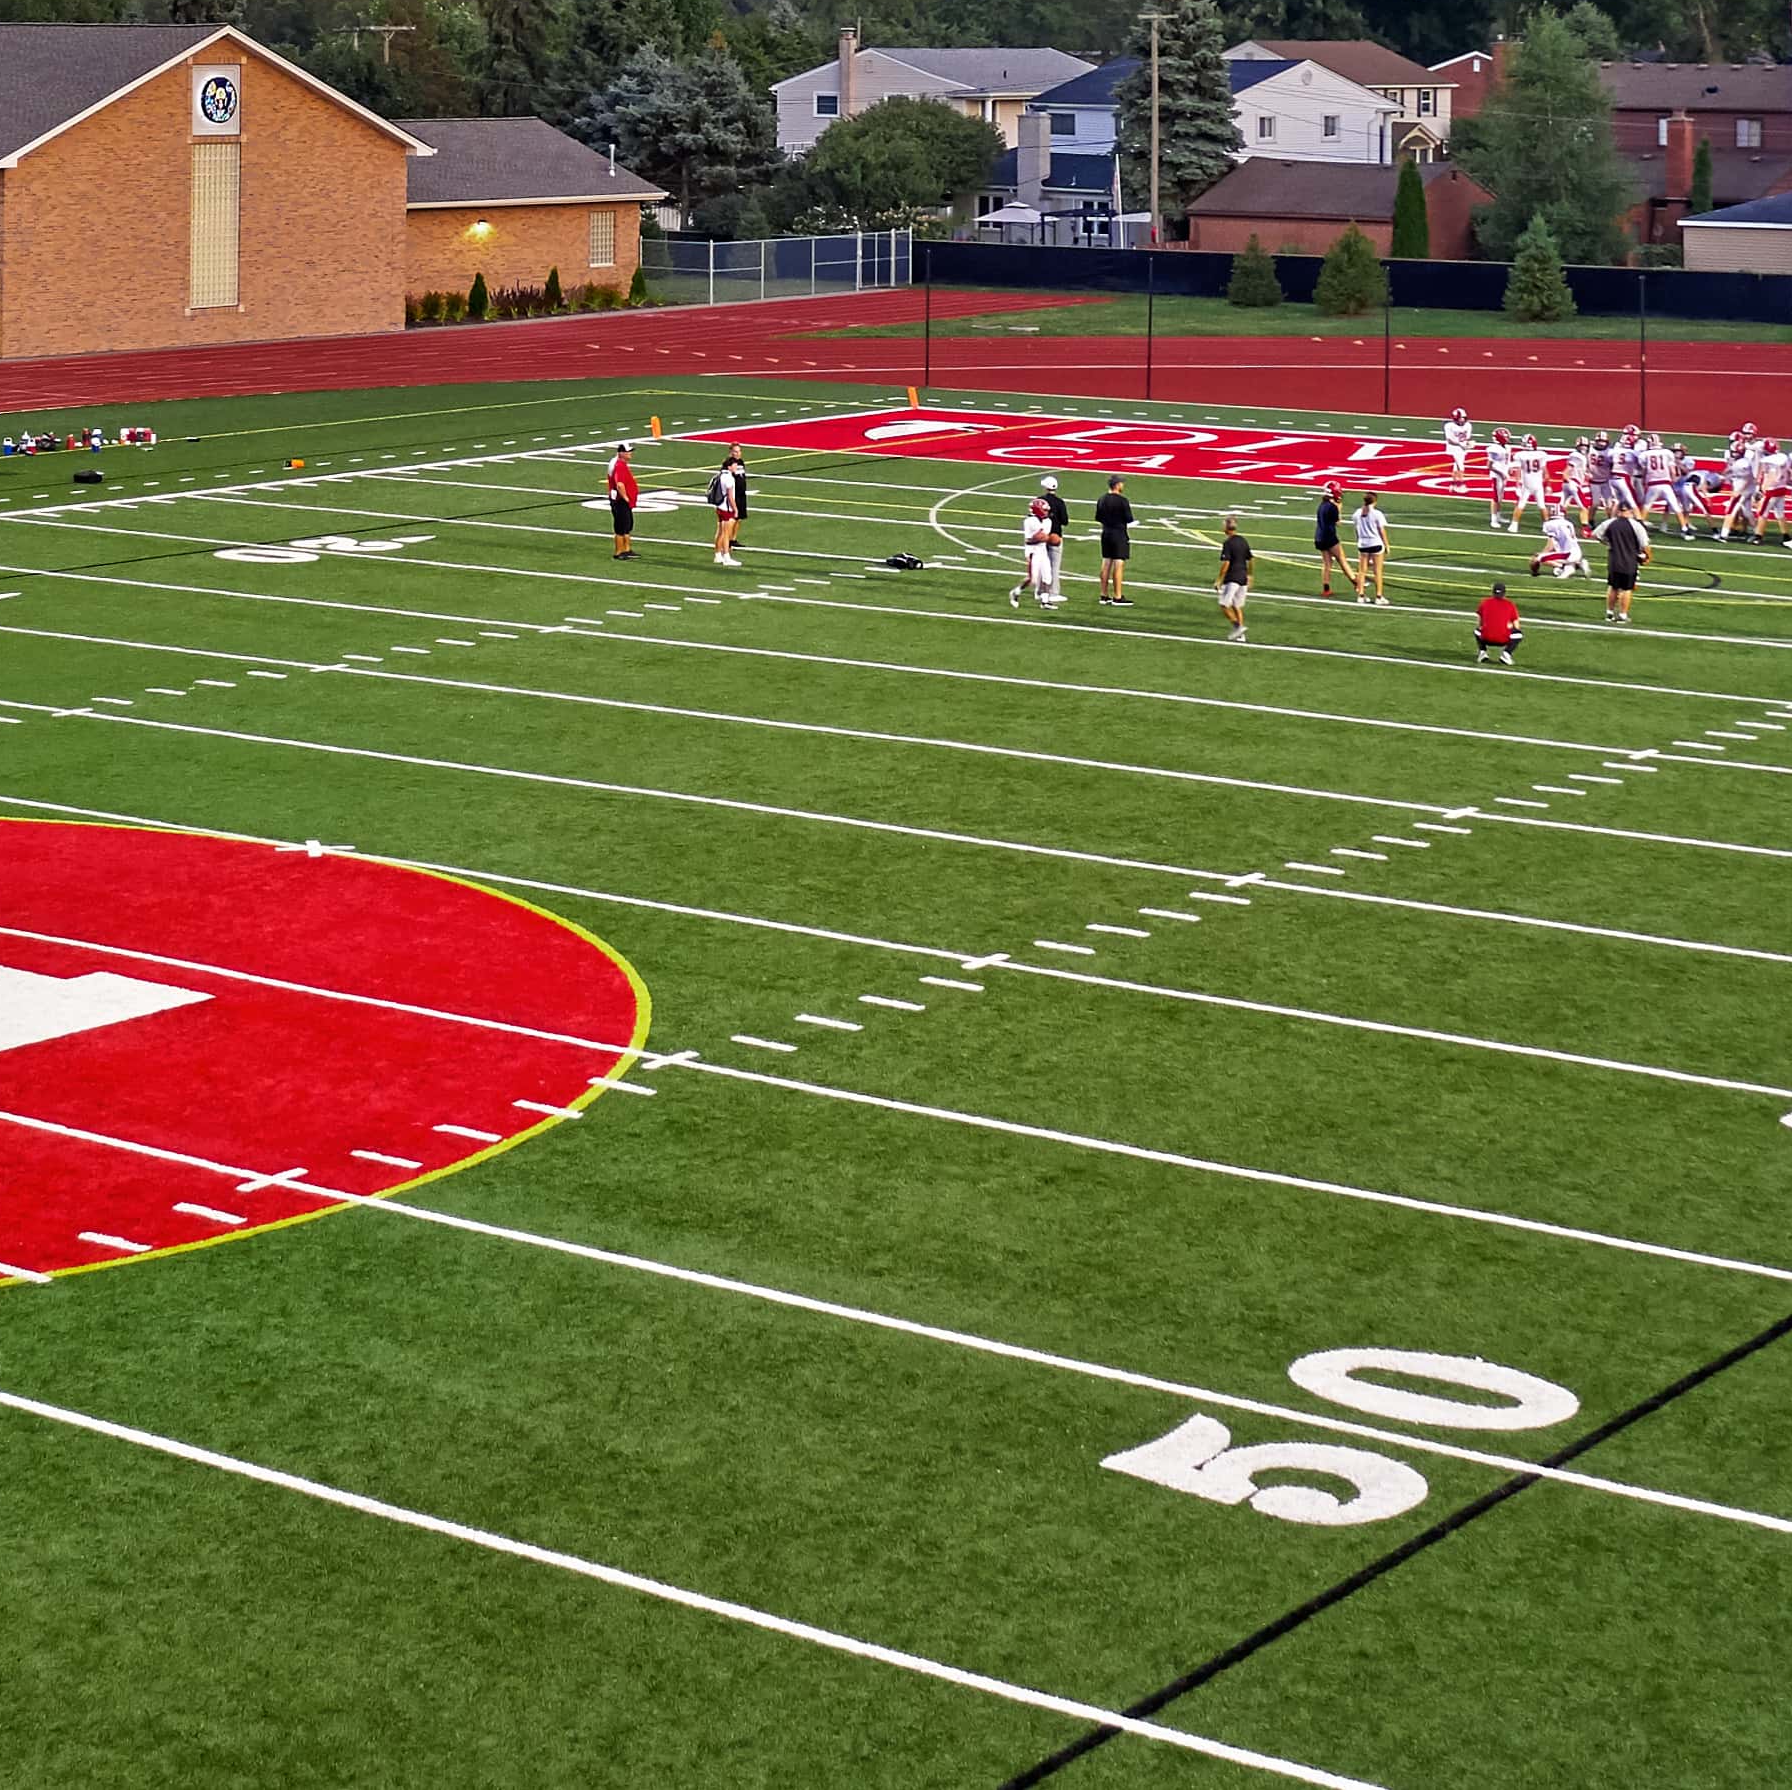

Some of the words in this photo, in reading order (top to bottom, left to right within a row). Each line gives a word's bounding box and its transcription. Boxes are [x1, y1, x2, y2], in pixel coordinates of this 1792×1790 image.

[1525, 458, 1541, 474] 19
[1650, 455, 1665, 471] 81
[212, 535, 404, 563] 20
[1099, 1346, 1580, 1526] 50
